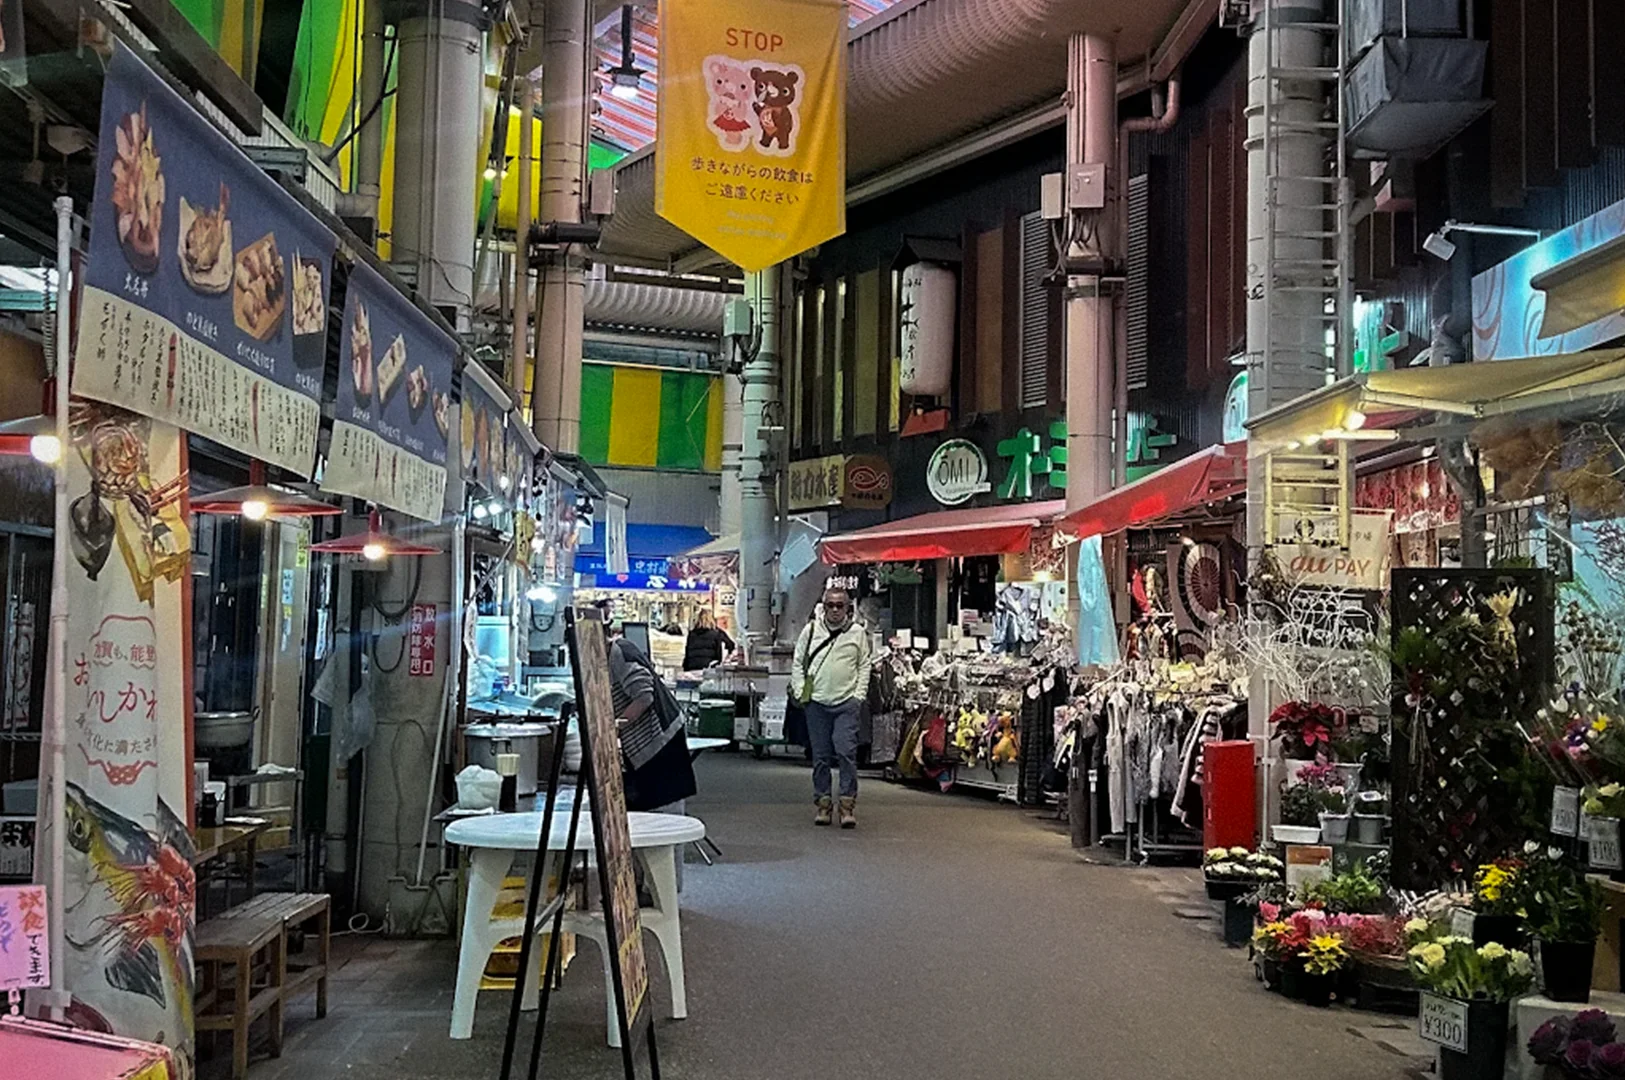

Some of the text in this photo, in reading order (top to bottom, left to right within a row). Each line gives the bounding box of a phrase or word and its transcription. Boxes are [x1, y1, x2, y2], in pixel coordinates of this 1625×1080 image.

[726, 28, 783, 52] STOP
[691, 156, 814, 184] 歩きながらの飲食は
[705, 183, 799, 205] ご遠慮ください
[1290, 556, 1371, 577] au PAY
[422, 607, 435, 674] 放水口
[1423, 1013, 1463, 1045] ¥300
